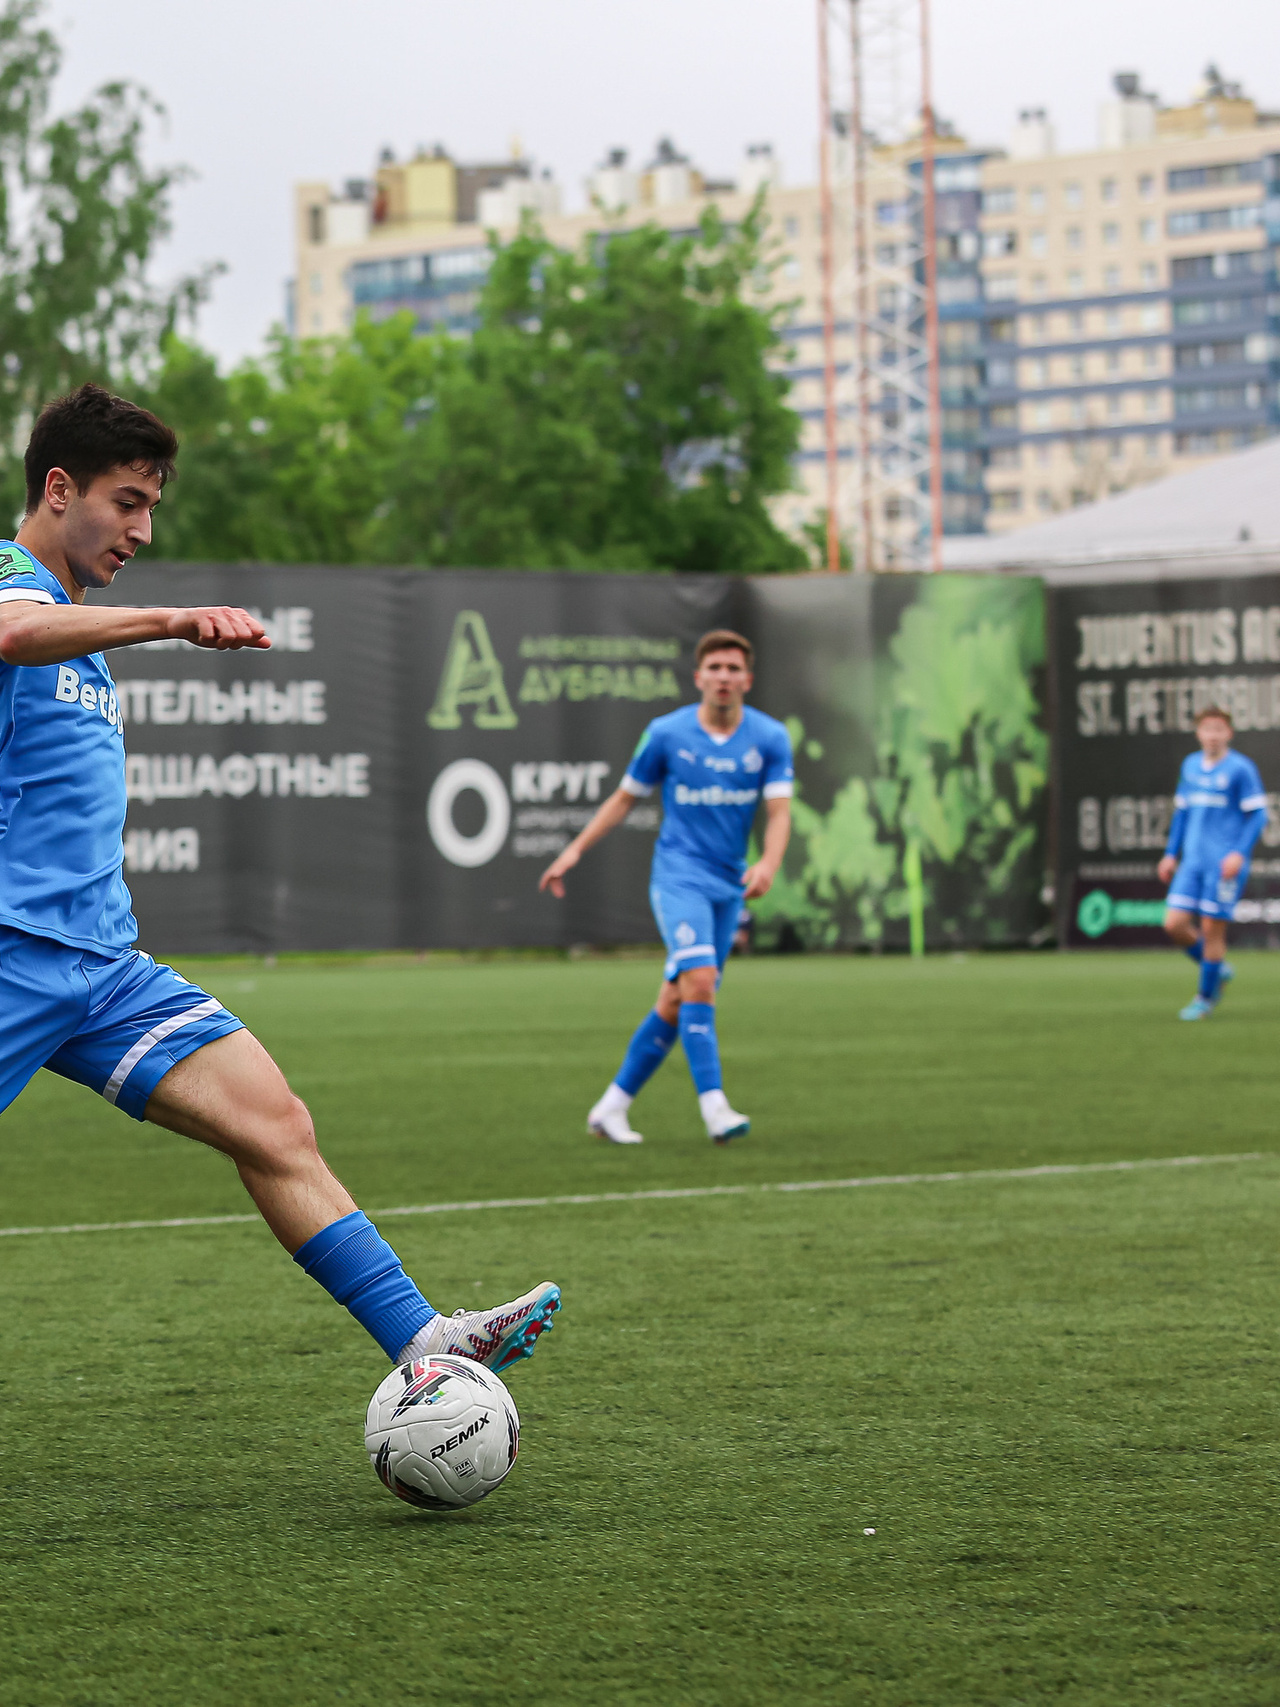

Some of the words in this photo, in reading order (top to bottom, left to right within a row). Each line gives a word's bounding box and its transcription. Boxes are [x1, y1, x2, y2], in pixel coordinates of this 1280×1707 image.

[1076, 608, 1237, 670] JUVENTUS
[126, 753, 371, 804] ДШАФТНЫЕ
[511, 761, 611, 802] КРУГ
[429, 1411, 491, 1460] DEMIX
